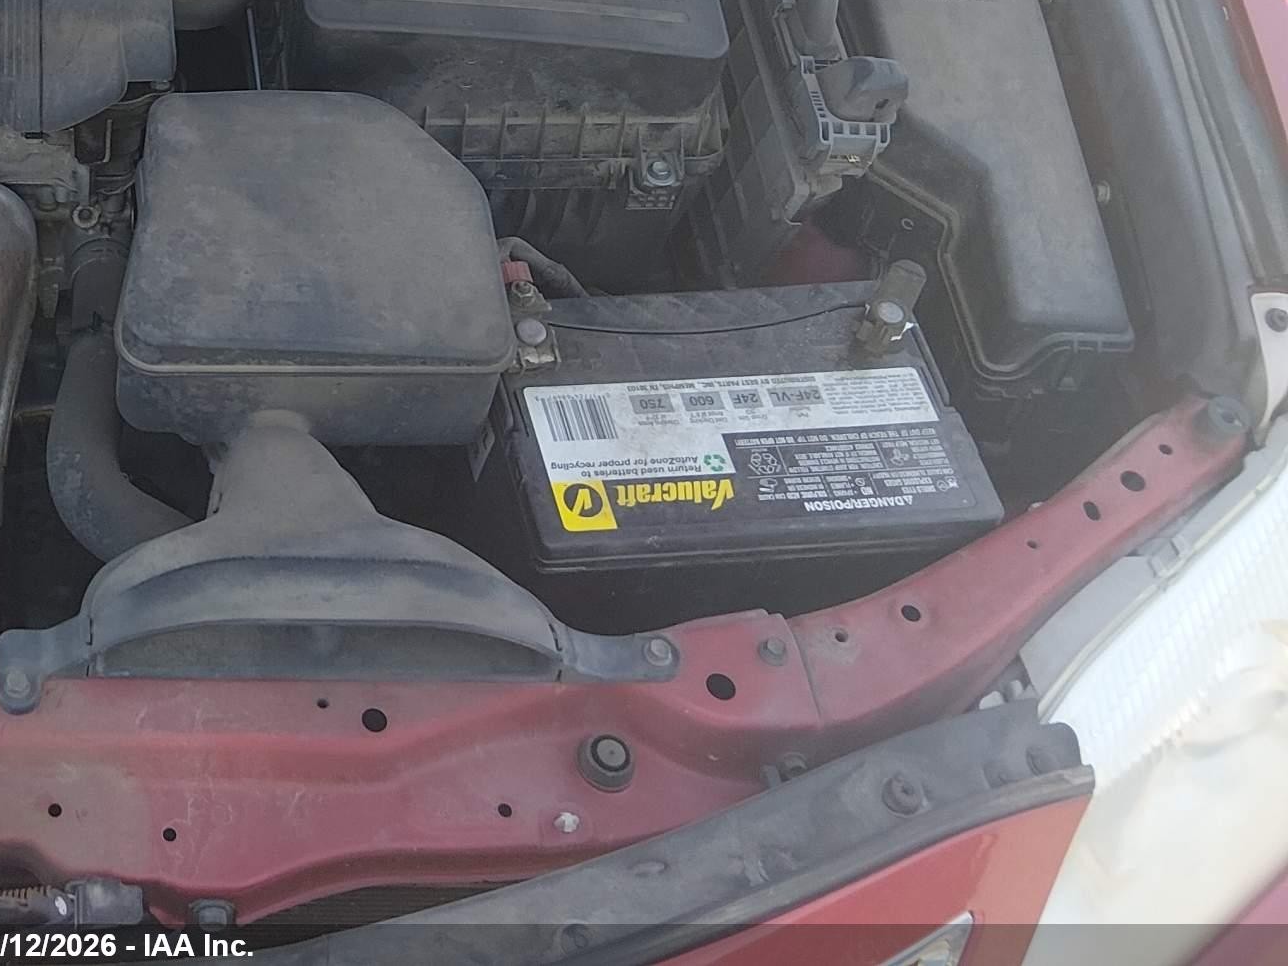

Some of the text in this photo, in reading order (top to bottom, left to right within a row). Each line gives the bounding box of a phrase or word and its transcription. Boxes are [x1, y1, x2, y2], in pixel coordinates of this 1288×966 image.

[741, 378, 758, 386] BEST
[689, 395, 715, 406] 600
[733, 393, 757, 406] 24F
[769, 386, 821, 403] 24F-VL
[639, 398, 665, 410] 750
[550, 455, 699, 471] AutoZone for proper recycling
[580, 464, 702, 478] Return used batteries to
[616, 478, 735, 511] Valucraft
[804, 496, 904, 512] DANGER/POISON
